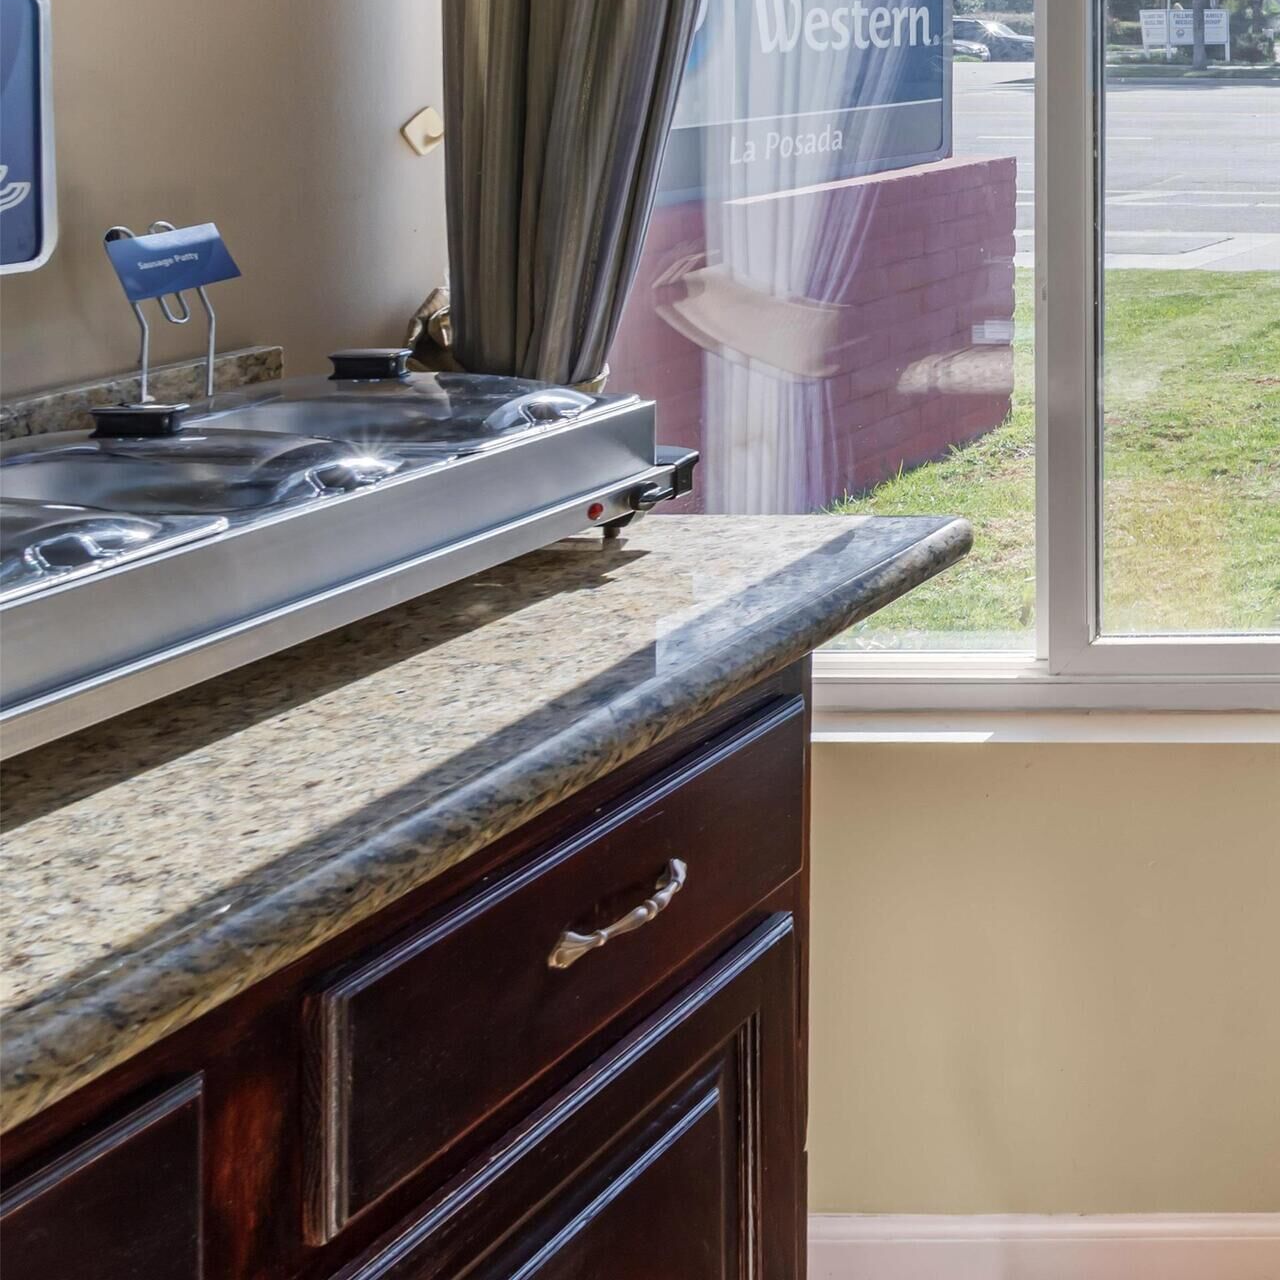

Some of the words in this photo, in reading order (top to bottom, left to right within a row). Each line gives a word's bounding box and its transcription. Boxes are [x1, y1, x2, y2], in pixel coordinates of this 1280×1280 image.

[730, 135, 756, 165] La
[765, 124, 843, 157] Posada
[137, 258, 174, 270] Sausage
[173, 252, 199, 262] Patty
